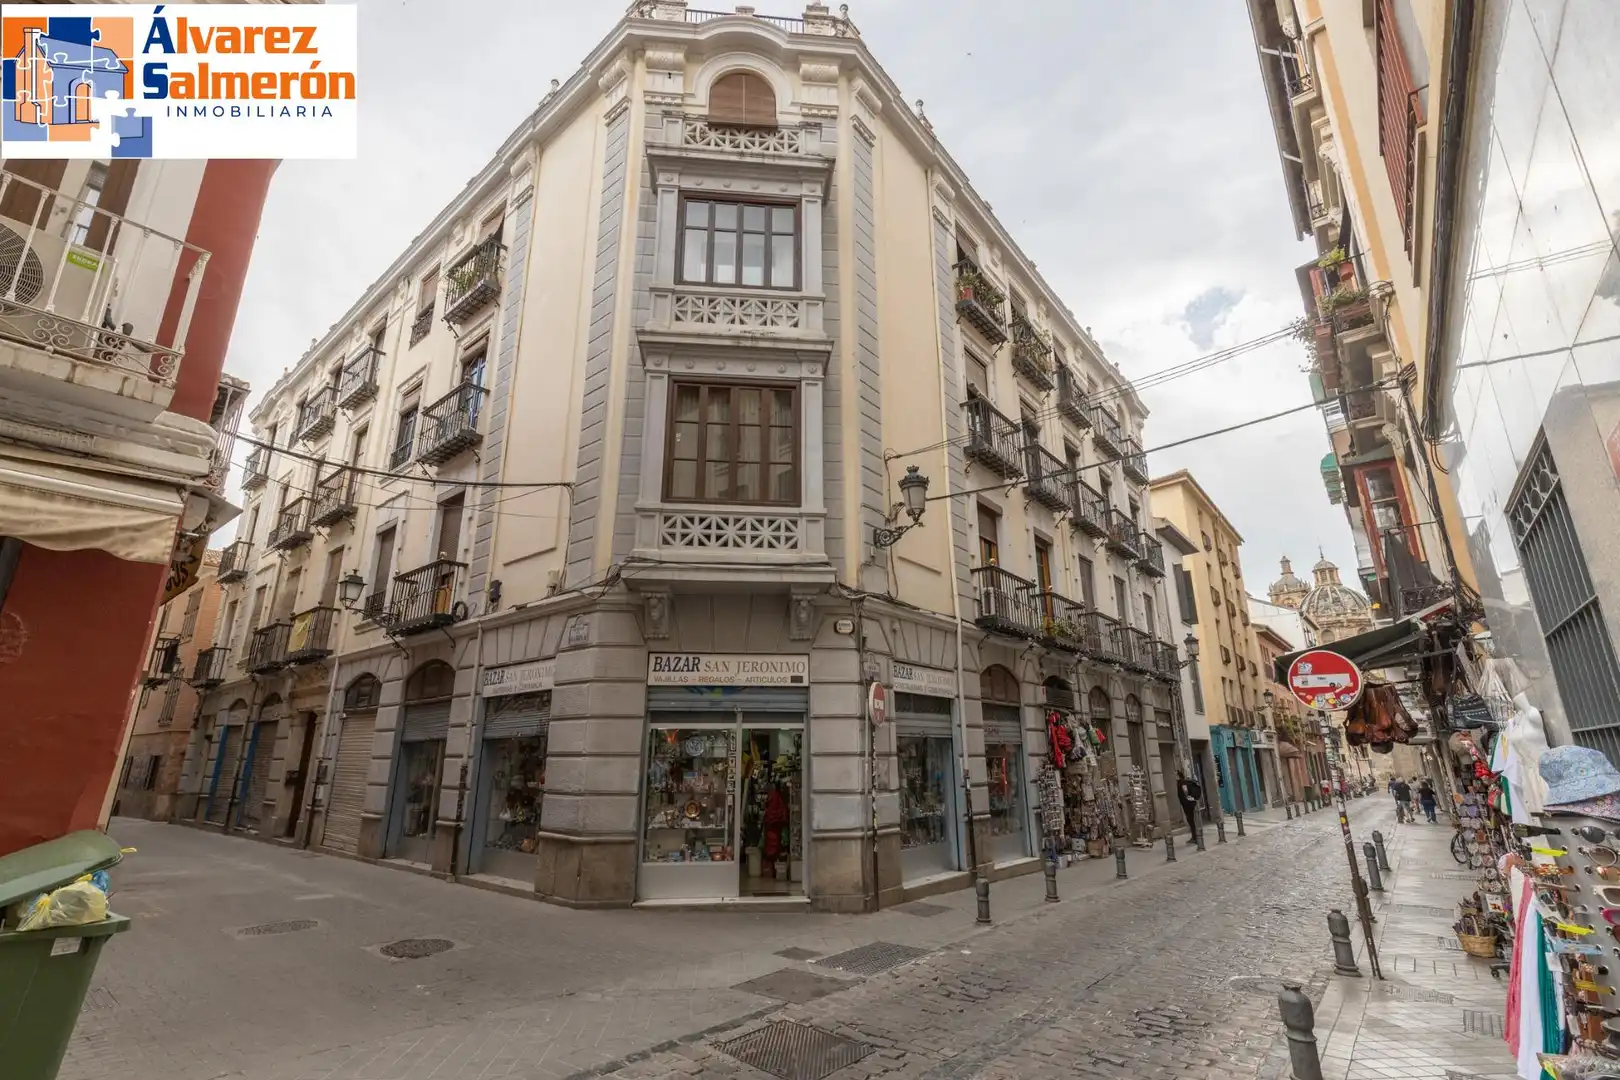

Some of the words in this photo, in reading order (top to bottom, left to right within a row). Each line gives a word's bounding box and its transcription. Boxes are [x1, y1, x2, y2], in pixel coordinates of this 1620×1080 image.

[652, 656, 701, 673] BAZAR
[704, 661, 730, 673] SAN
[734, 661, 806, 677] JERONIMO
[893, 665, 913, 680] BAZAR
[484, 670, 505, 687] BAZAR
[653, 675, 689, 683] VAJILLAS
[698, 676, 735, 684] REGALOS
[745, 676, 788, 684] ARTICULOS
